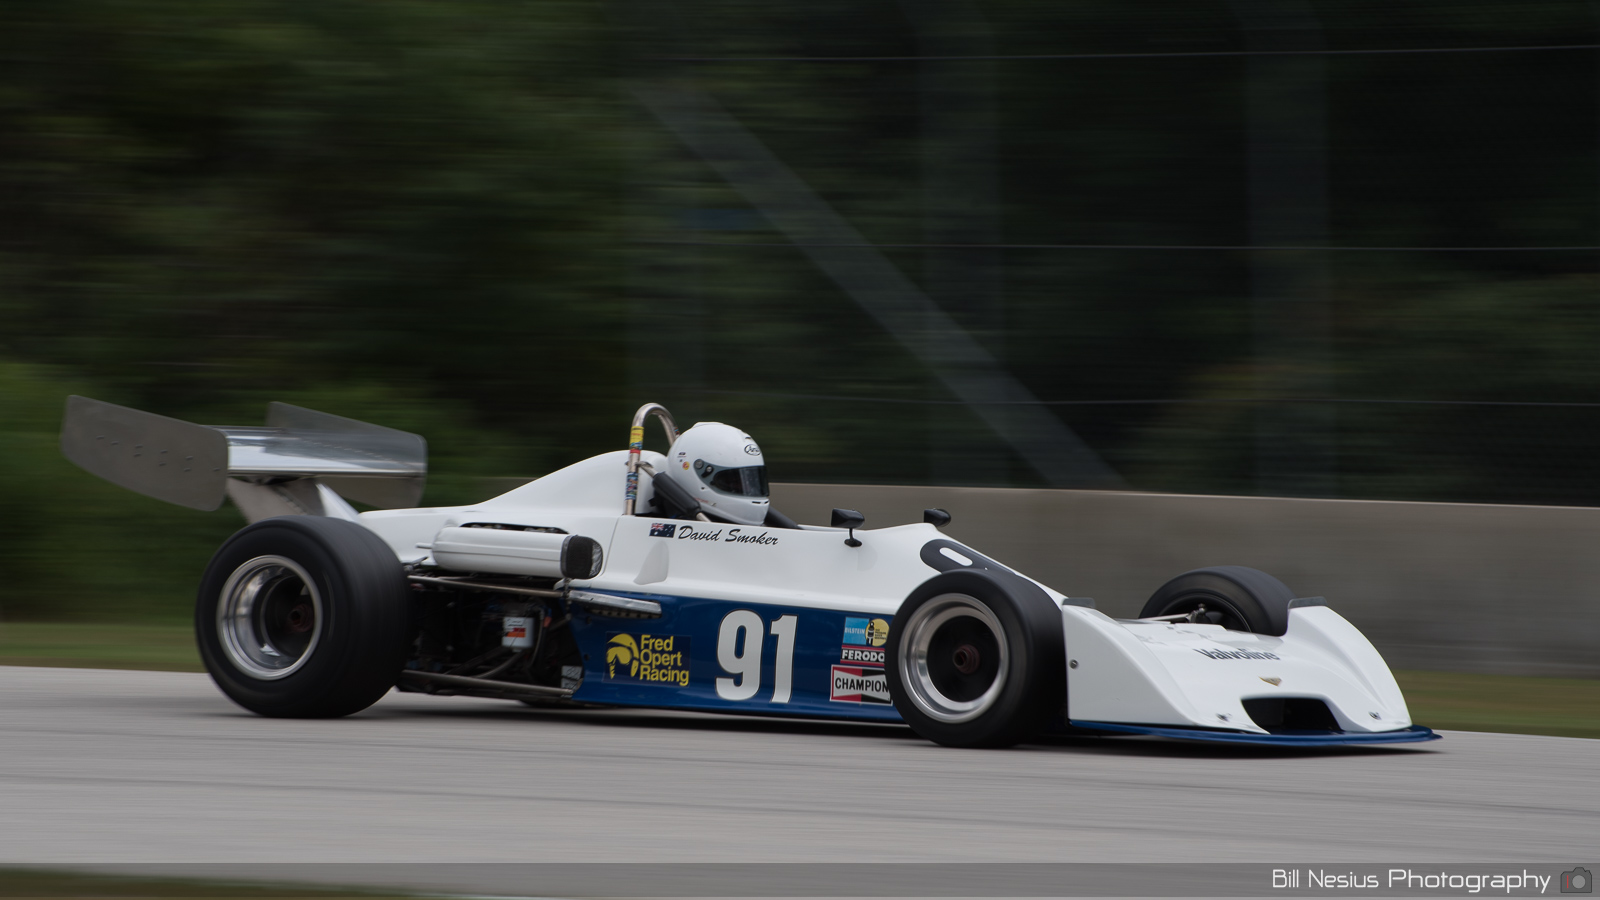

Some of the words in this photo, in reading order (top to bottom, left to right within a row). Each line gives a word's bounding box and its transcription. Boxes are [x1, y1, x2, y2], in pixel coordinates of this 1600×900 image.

[678, 525, 722, 541] David
[725, 528, 778, 545] Smoker
[845, 627, 865, 635] BILSTEIN
[640, 634, 674, 651] Fred
[640, 649, 682, 669] Opert
[715, 609, 798, 704] 91
[841, 649, 885, 662] FERODO
[1192, 647, 1281, 660] Valvoline
[639, 666, 690, 686] Racing
[835, 677, 889, 693] CHAMPION
